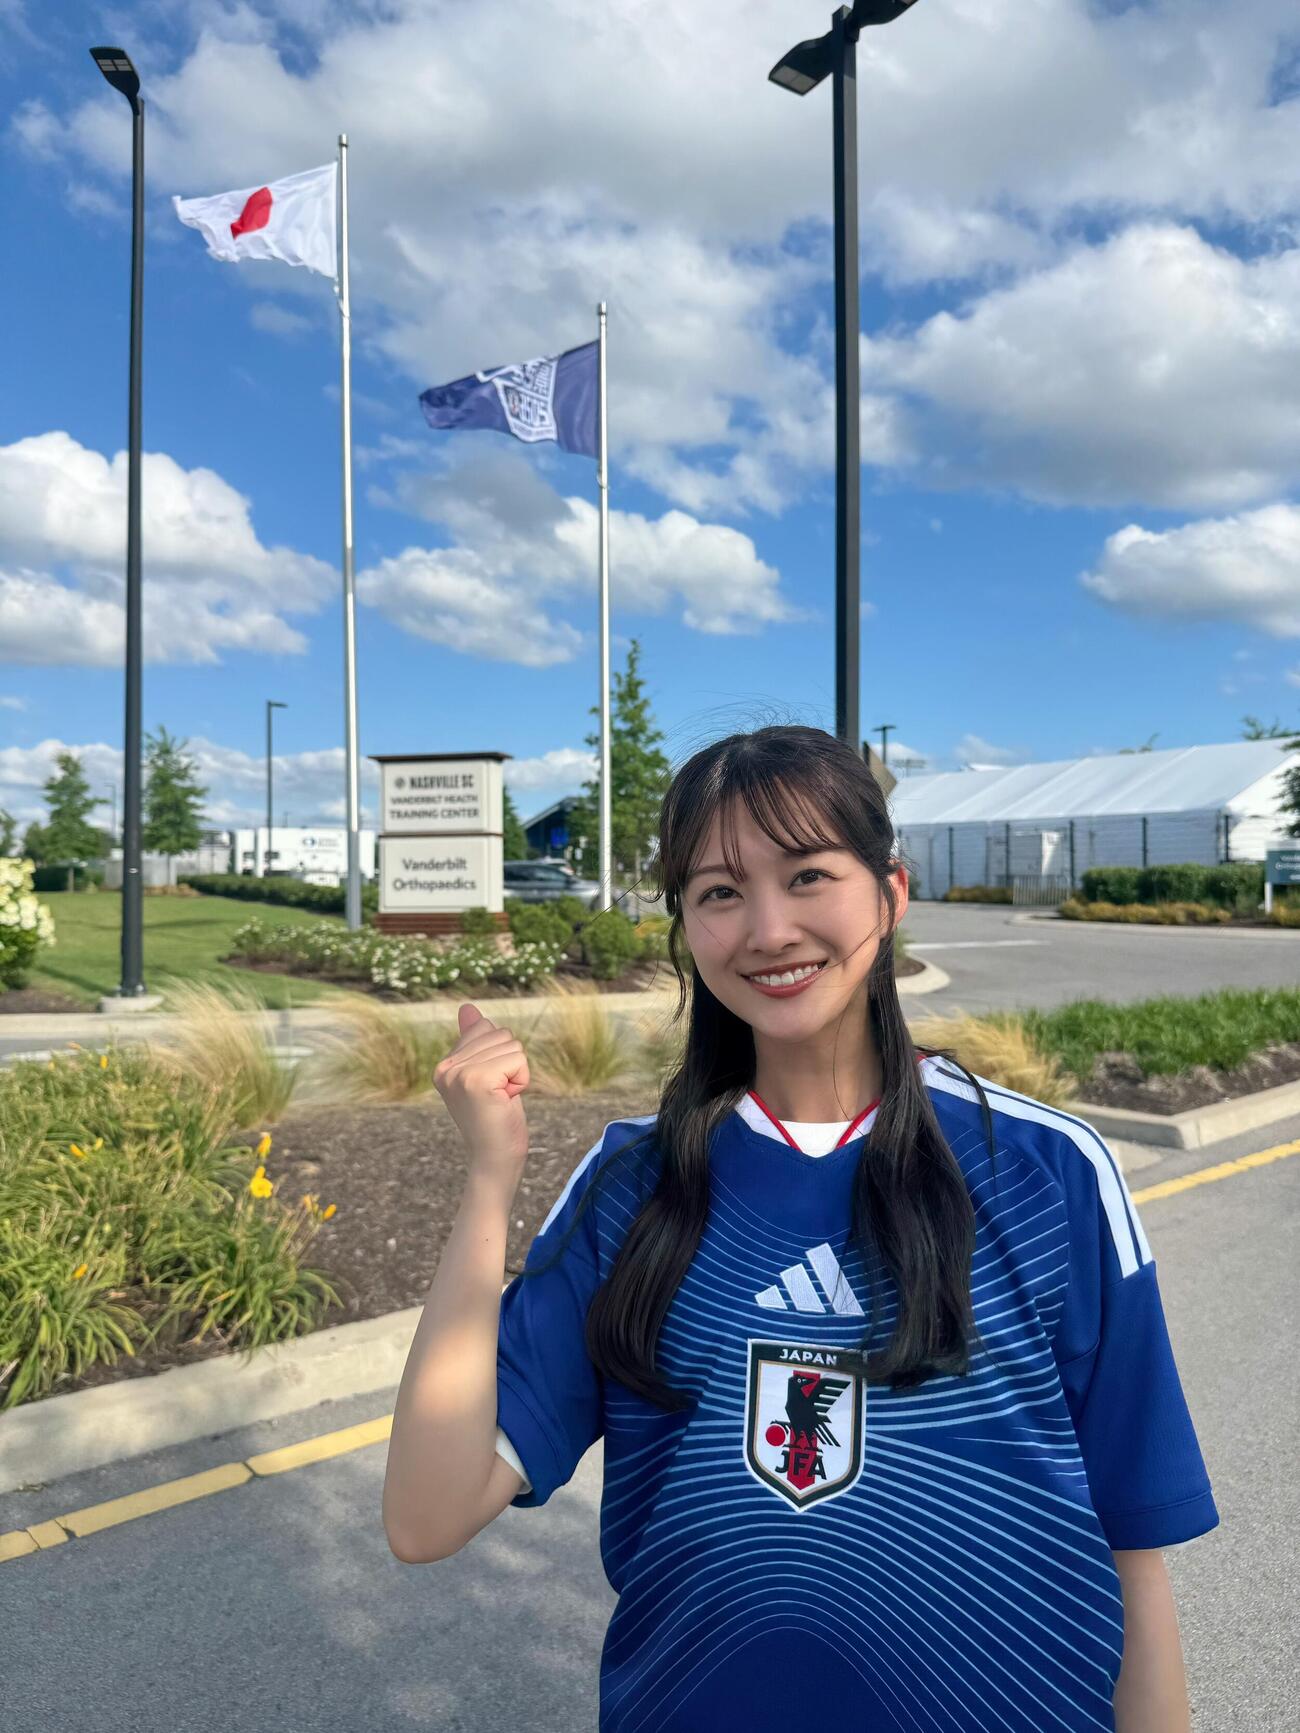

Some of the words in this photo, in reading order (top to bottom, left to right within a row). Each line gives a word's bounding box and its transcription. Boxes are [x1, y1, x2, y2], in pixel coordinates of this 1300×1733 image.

[409, 775, 459, 789] NASHVILLE
[462, 774, 474, 788] SC
[391, 795, 442, 805] VANDERBILT
[445, 794, 479, 803] HEALTH
[390, 809, 438, 820] TRAINING
[441, 808, 479, 819] CENTER
[402, 858, 467, 871] Vanderbilt
[393, 877, 476, 893] Orthopaedics
[779, 1348, 838, 1366] JAPAN
[775, 1450, 827, 1480] JFA
